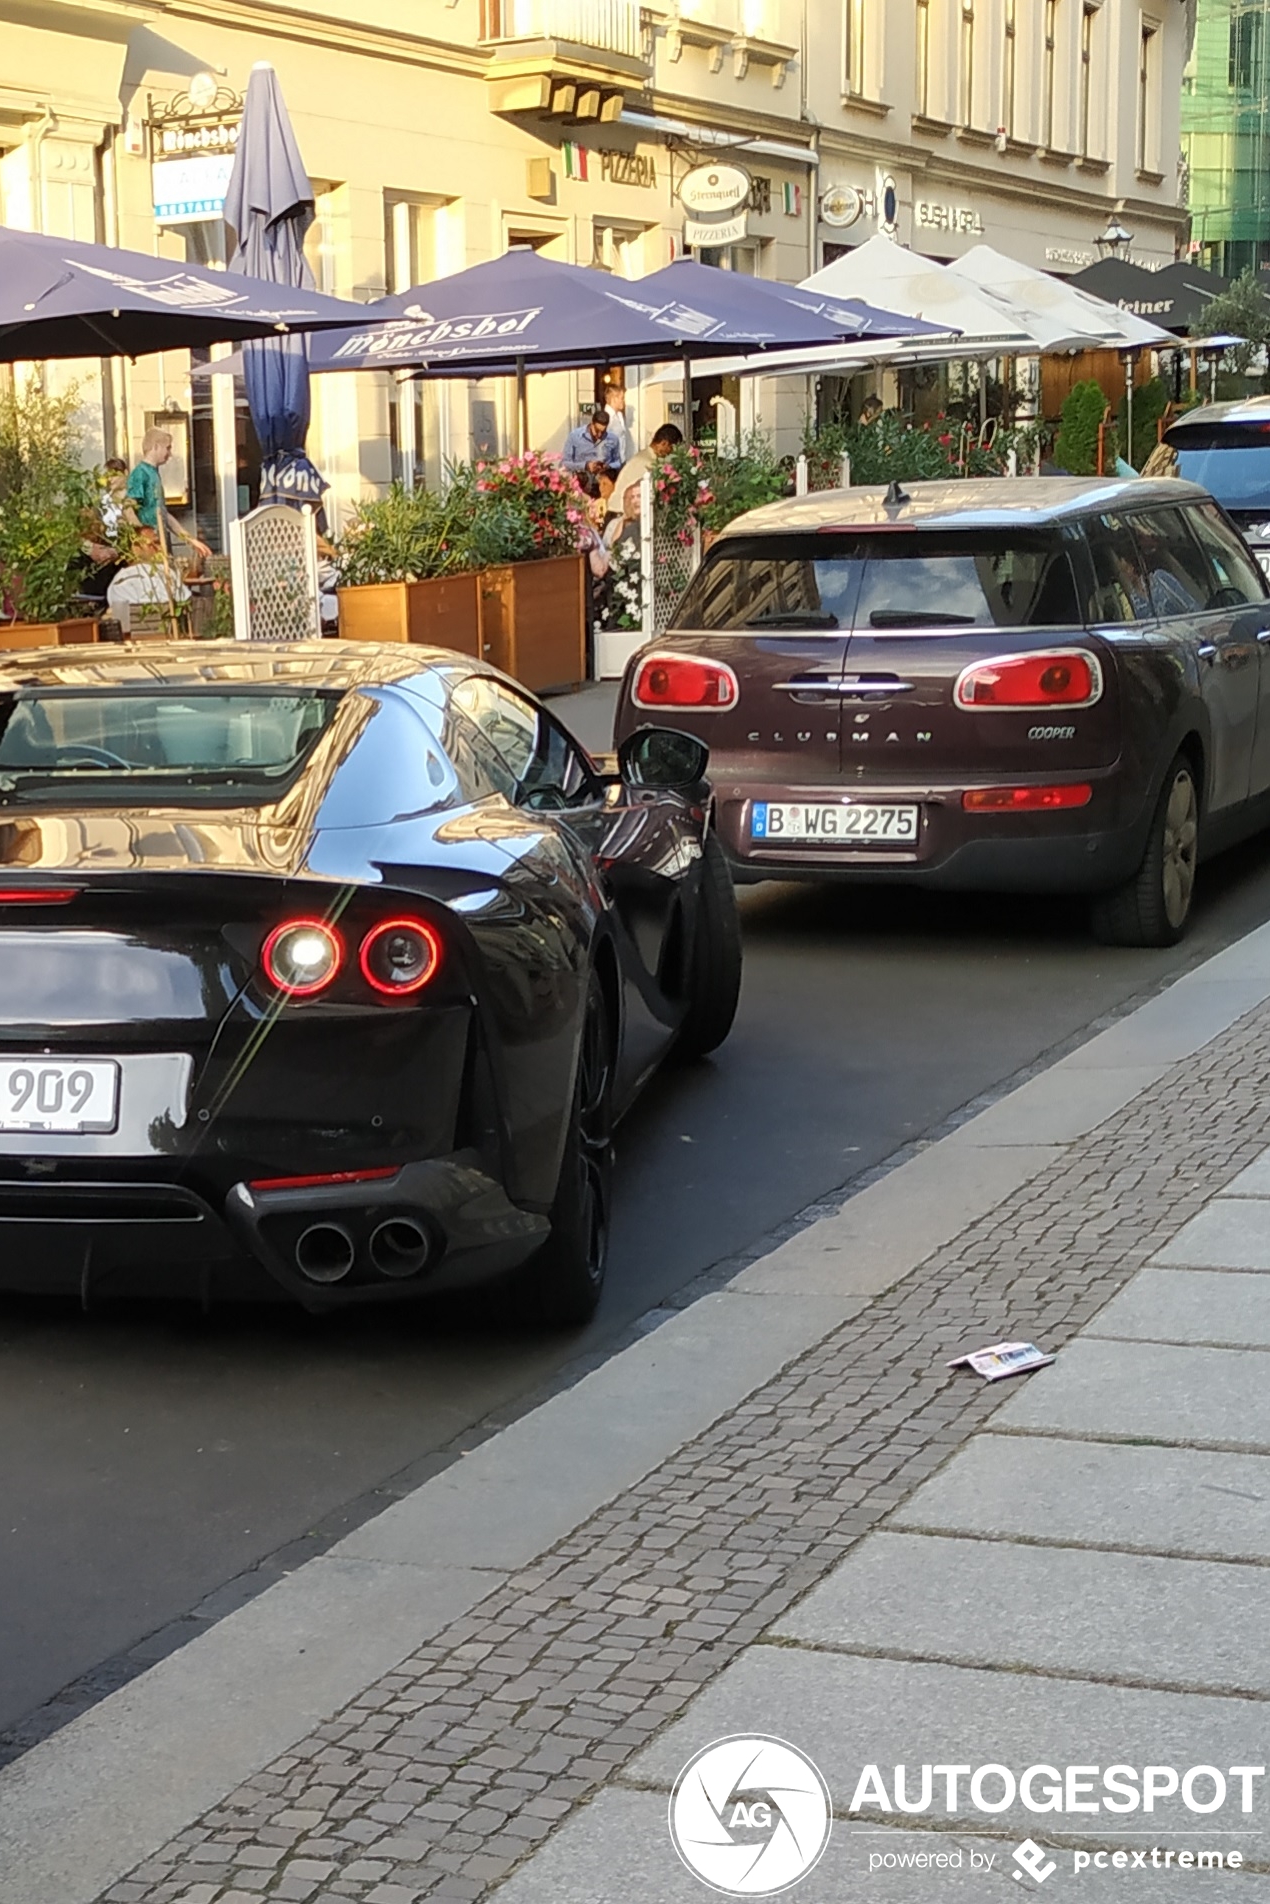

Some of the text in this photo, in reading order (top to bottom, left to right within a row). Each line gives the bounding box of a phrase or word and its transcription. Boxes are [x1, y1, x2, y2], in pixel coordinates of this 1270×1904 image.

[601, 150, 658, 188] PIZZERIA
[693, 226, 740, 240] PIZZERIA
[747, 730, 932, 743] CLUBMAN
[1028, 725, 1076, 741] COOPER
[768, 808, 915, 836] B WG 2275
[8, 1068, 94, 1113] 909
